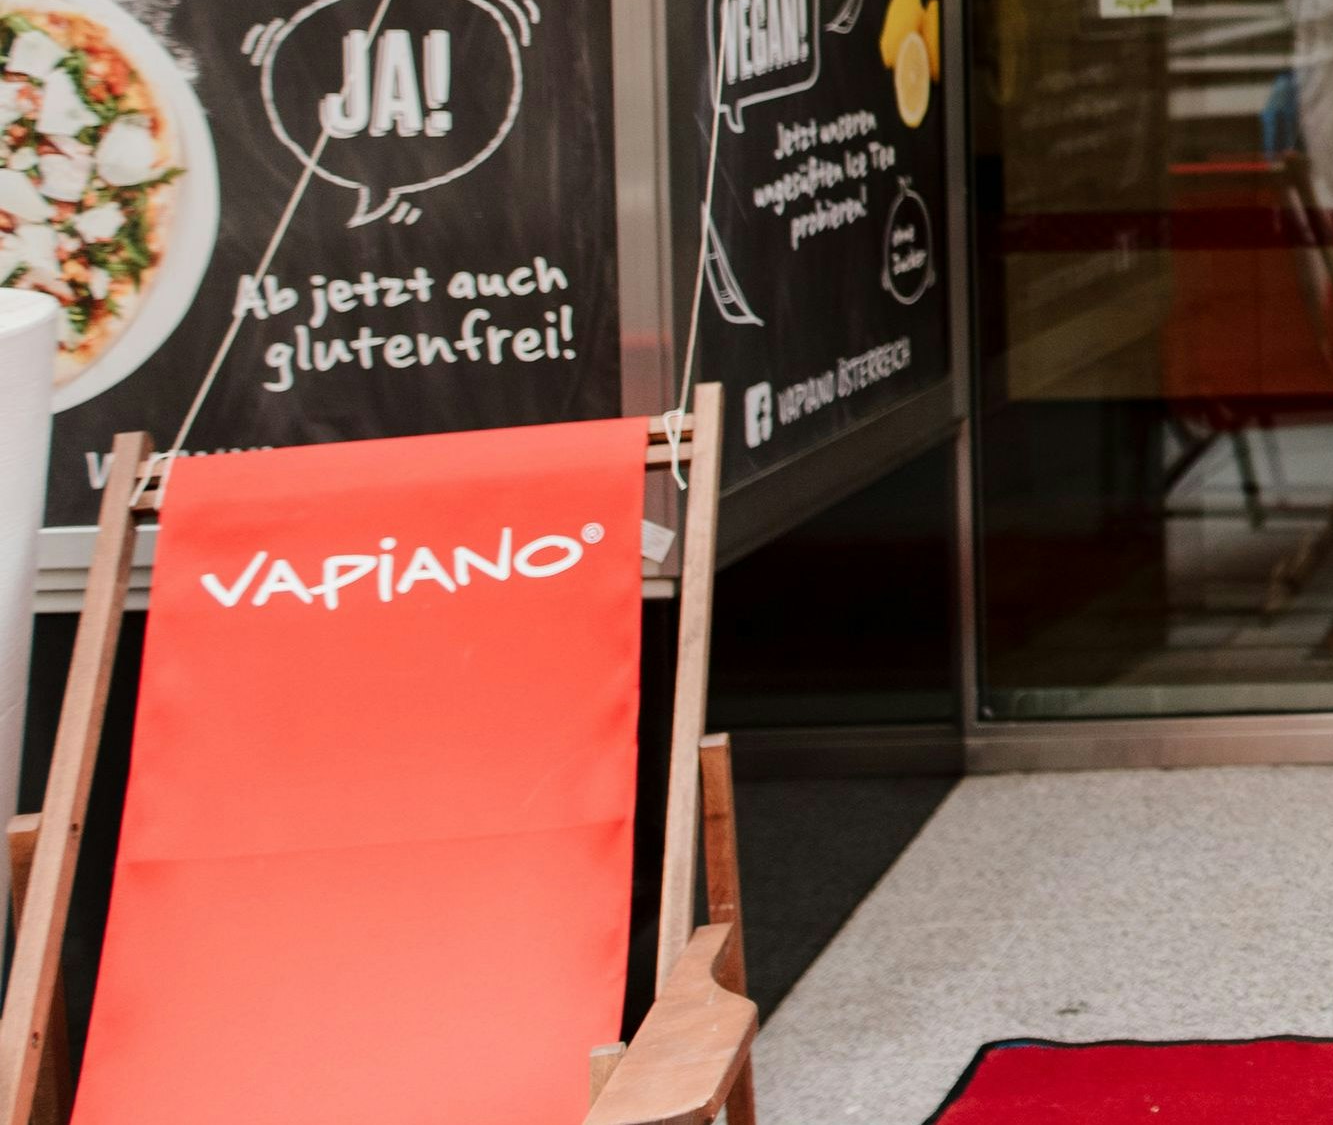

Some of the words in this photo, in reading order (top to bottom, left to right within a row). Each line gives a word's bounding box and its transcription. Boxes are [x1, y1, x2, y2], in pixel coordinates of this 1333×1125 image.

[319, 29, 452, 137] JA!
[774, 118, 817, 160] Jetzt
[233, 273, 299, 320] Ab
[309, 267, 435, 328] jetzt
[446, 257, 569, 301] auch
[262, 305, 577, 392] glutenfrei!
